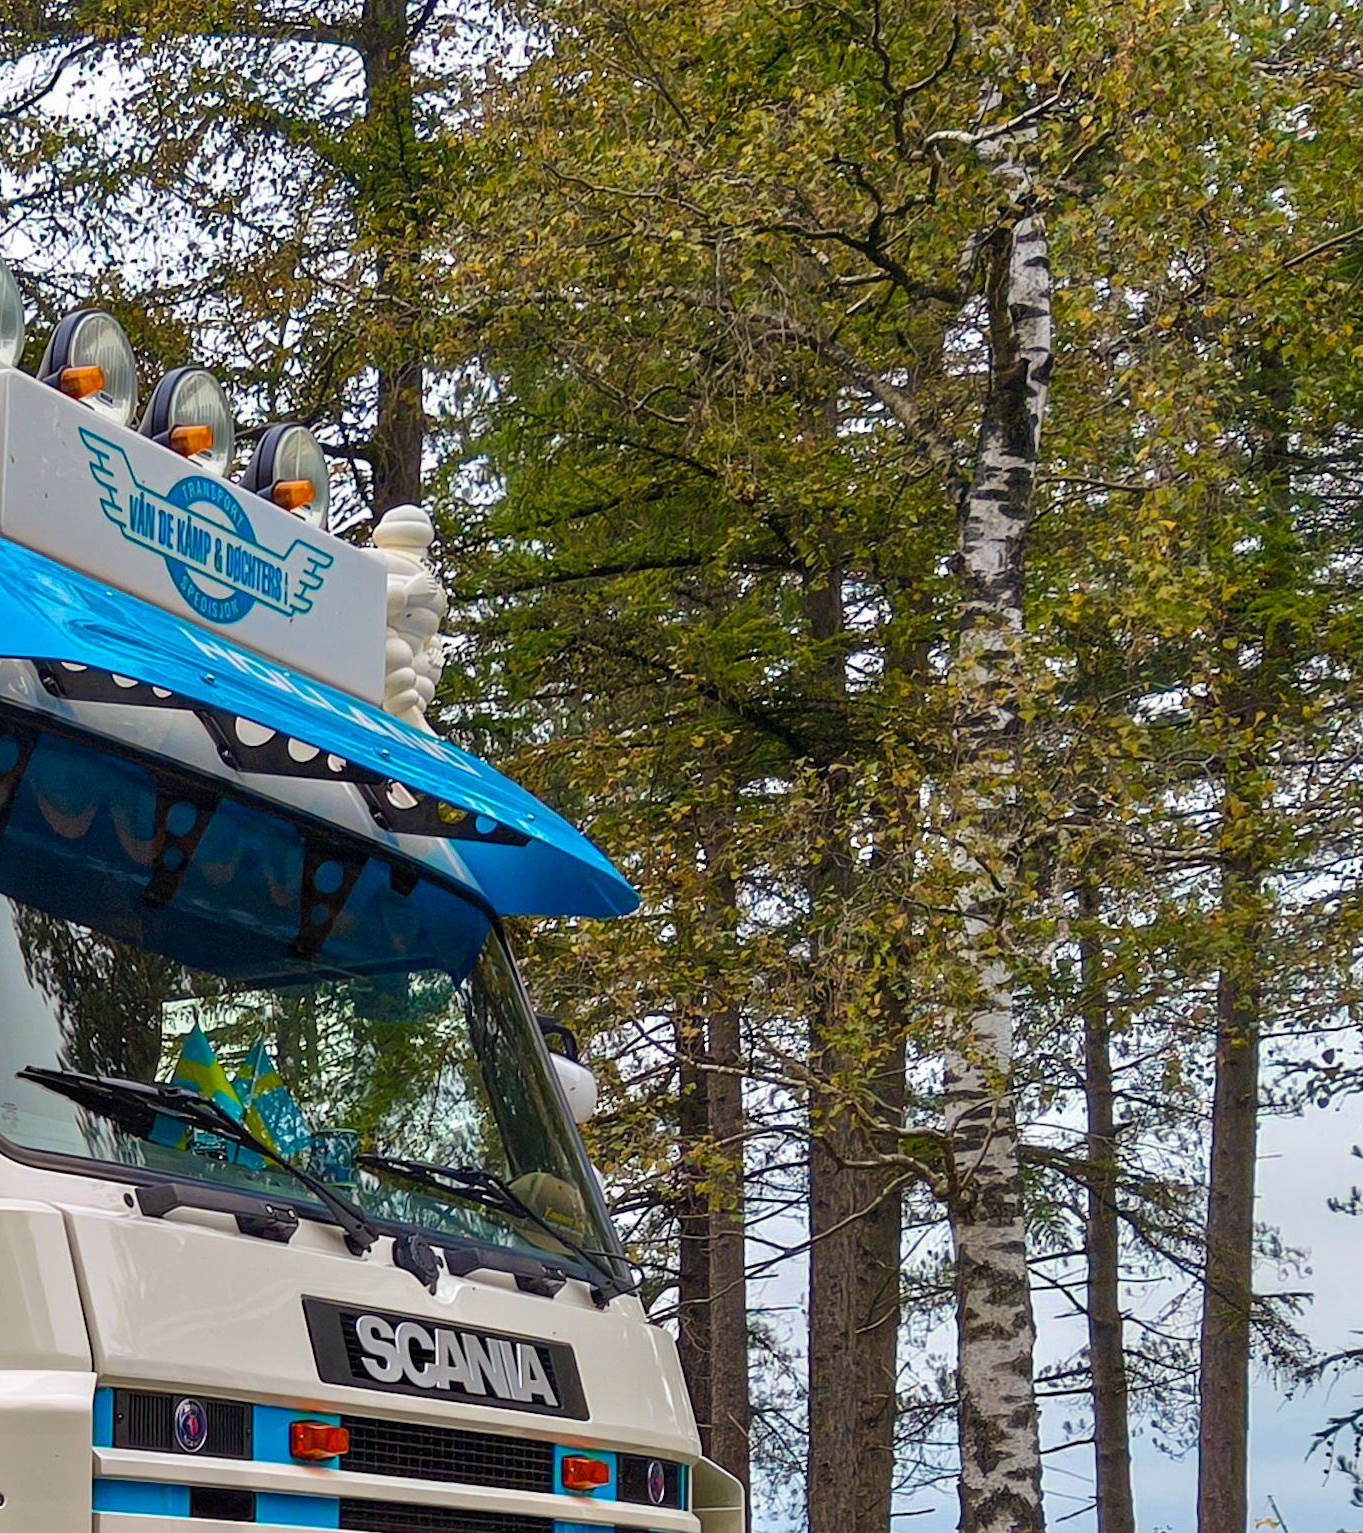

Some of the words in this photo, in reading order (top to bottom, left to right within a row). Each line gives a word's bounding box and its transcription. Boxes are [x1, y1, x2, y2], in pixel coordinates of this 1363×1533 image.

[181, 480, 244, 527] TRANSPORT
[158, 509, 174, 550] DE
[214, 537, 224, 574] &
[354, 1314, 559, 1407] SCANIA
